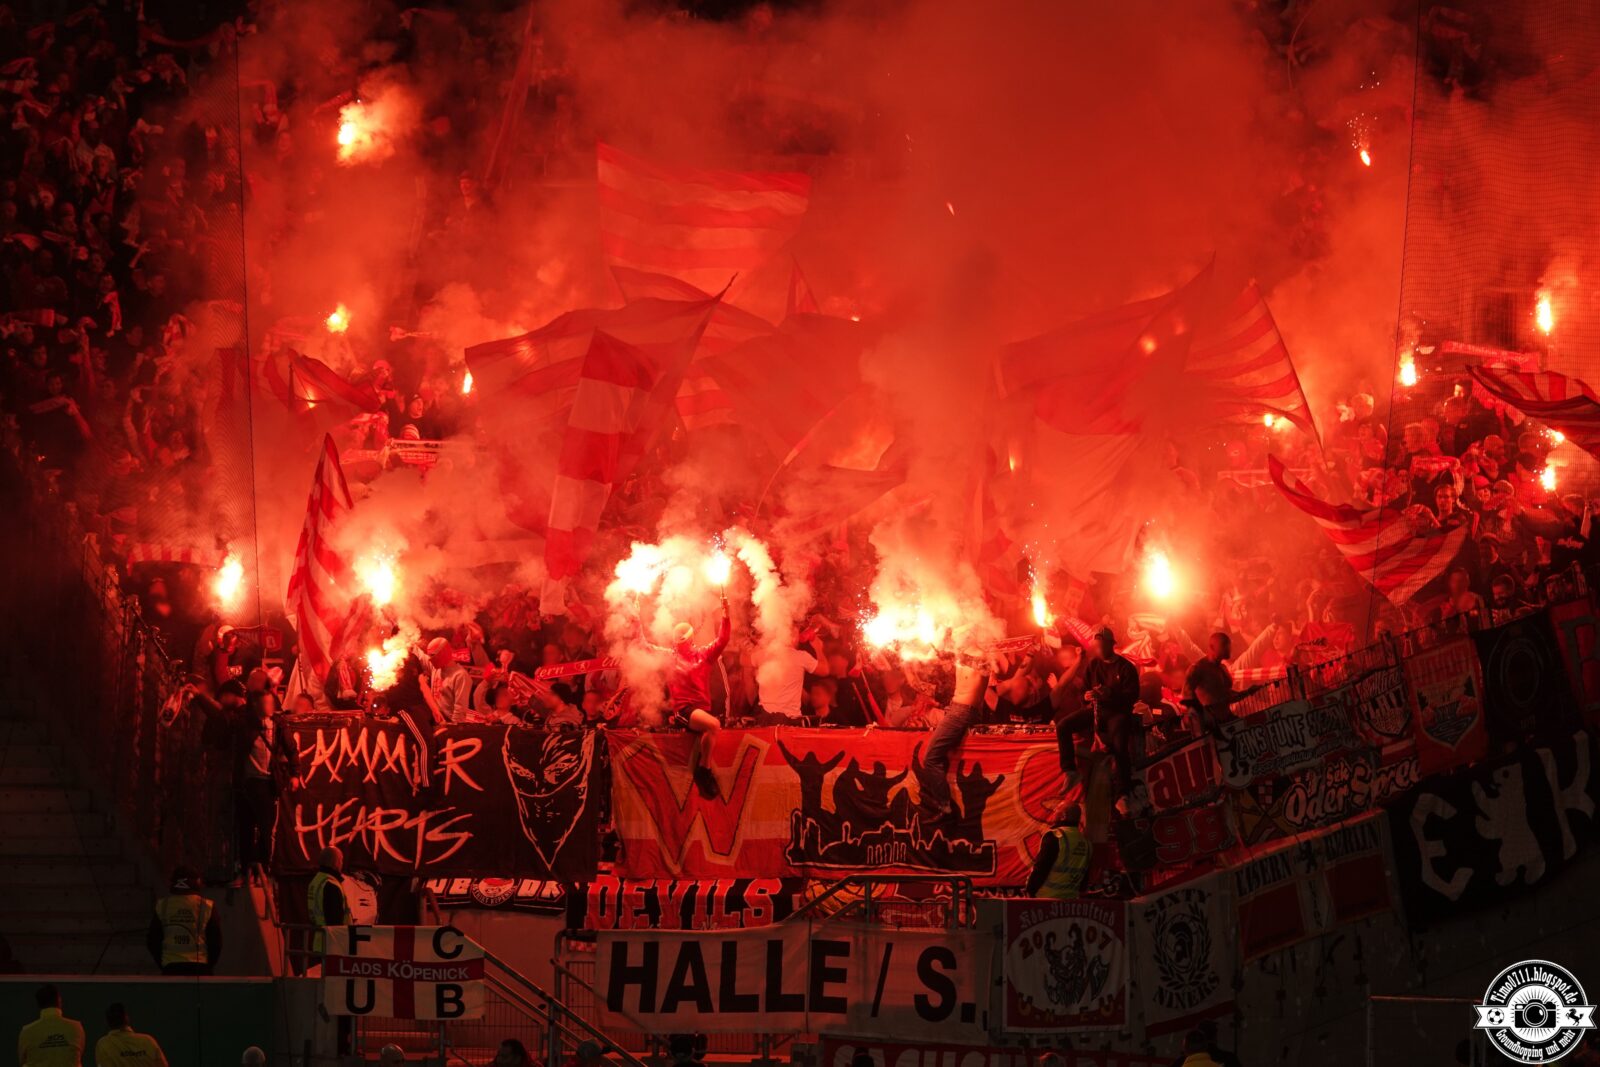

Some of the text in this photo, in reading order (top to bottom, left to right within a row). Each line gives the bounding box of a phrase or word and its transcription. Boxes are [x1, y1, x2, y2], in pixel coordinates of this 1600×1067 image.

[294, 797, 475, 872] HEARTS
[584, 875, 782, 930] DEVILS
[433, 926, 464, 959] C
[339, 958, 470, 981] LADS KÖPENICK
[607, 940, 851, 1014] HALLE
[346, 980, 466, 1019] U B
